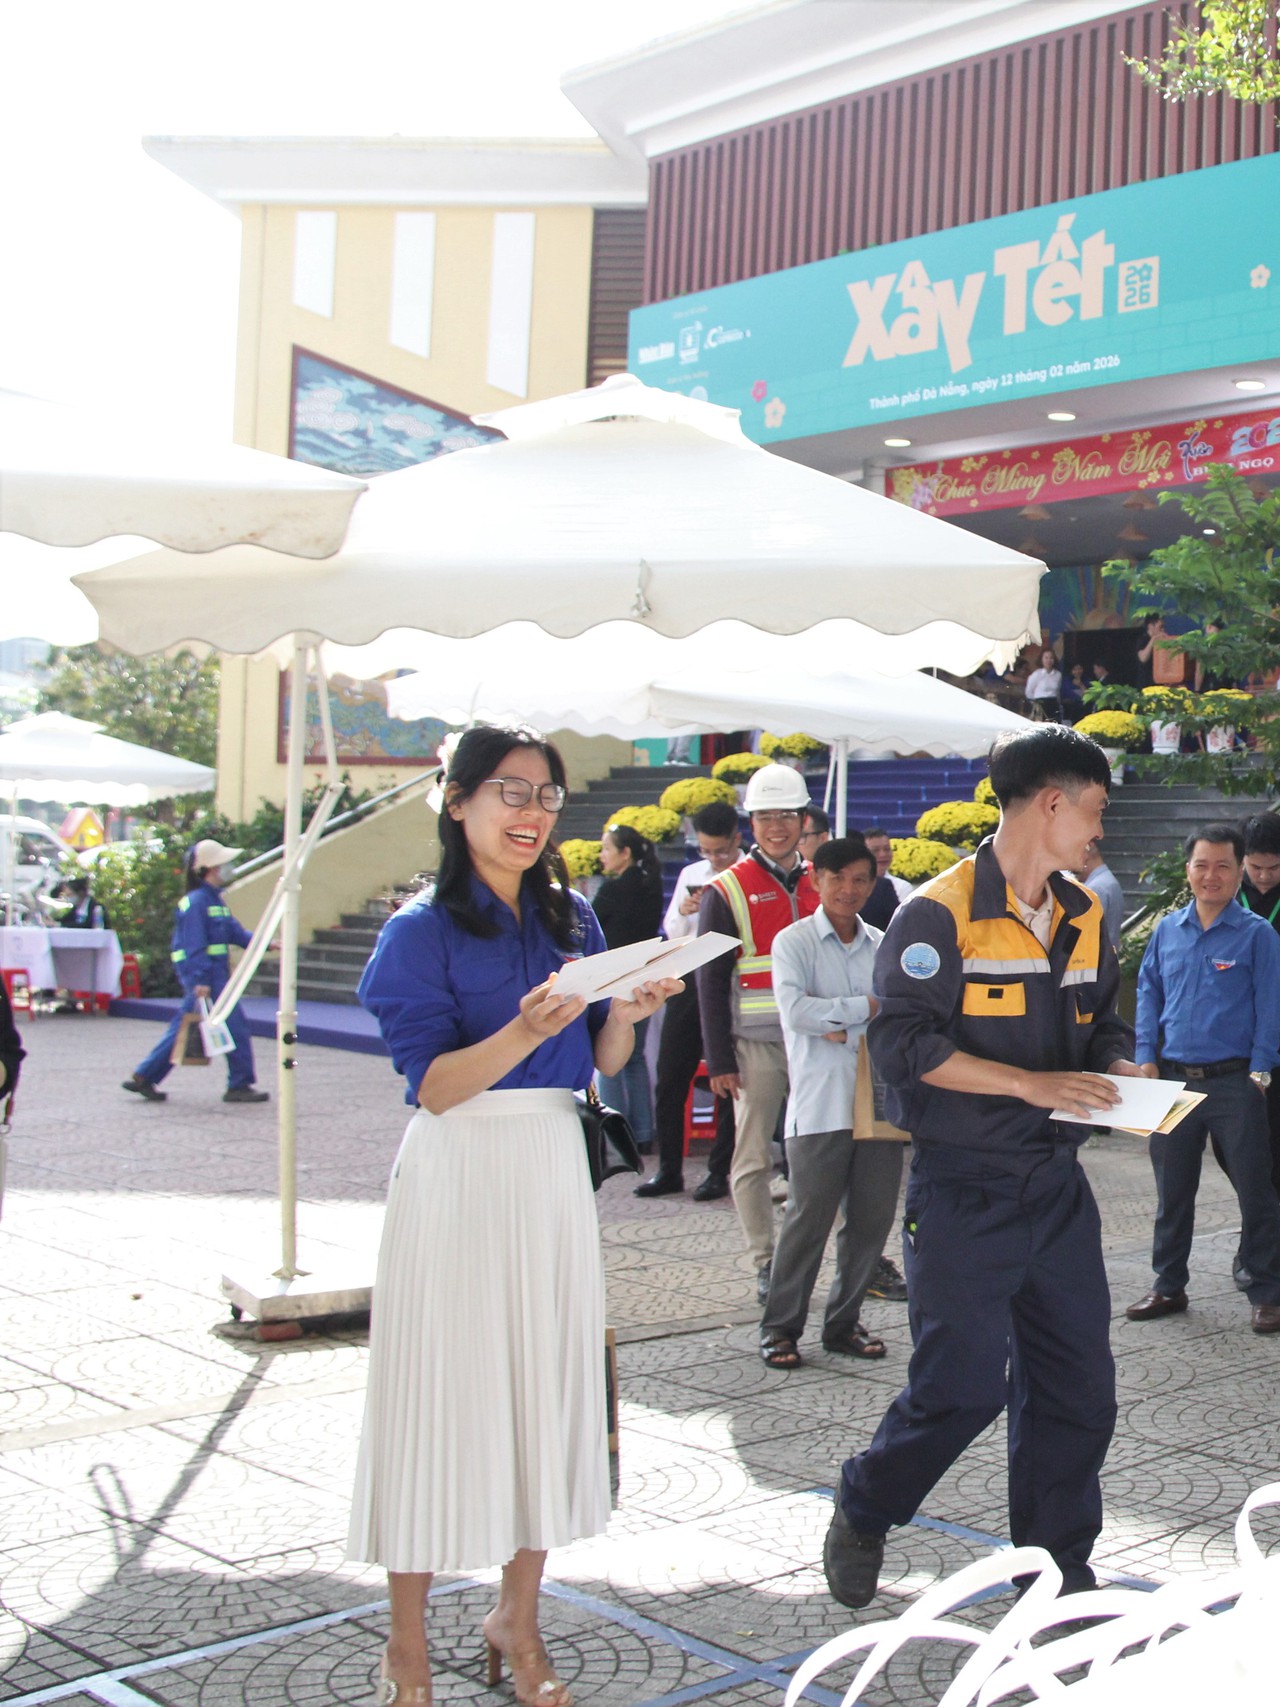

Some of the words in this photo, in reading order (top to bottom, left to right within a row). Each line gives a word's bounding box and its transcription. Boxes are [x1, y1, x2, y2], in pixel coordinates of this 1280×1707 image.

[843, 260, 985, 374] Xây
[994, 213, 1115, 335] Tết
[869, 394, 900, 409] Thành
[901, 387, 921, 407] phố
[971, 376, 999, 393] ngày
[1001, 373, 1013, 386] 12
[1015, 368, 1047, 382] tháng
[1049, 364, 1063, 378] 02
[1065, 360, 1091, 375] năm
[1093, 354, 1121, 370] 2026
[932, 473, 977, 503] Chúc
[981, 462, 1047, 501] Mừng
[1051, 451, 1112, 485] Năm
[1118, 440, 1172, 476] Mới
[1239, 457, 1275, 470] NGỌ
